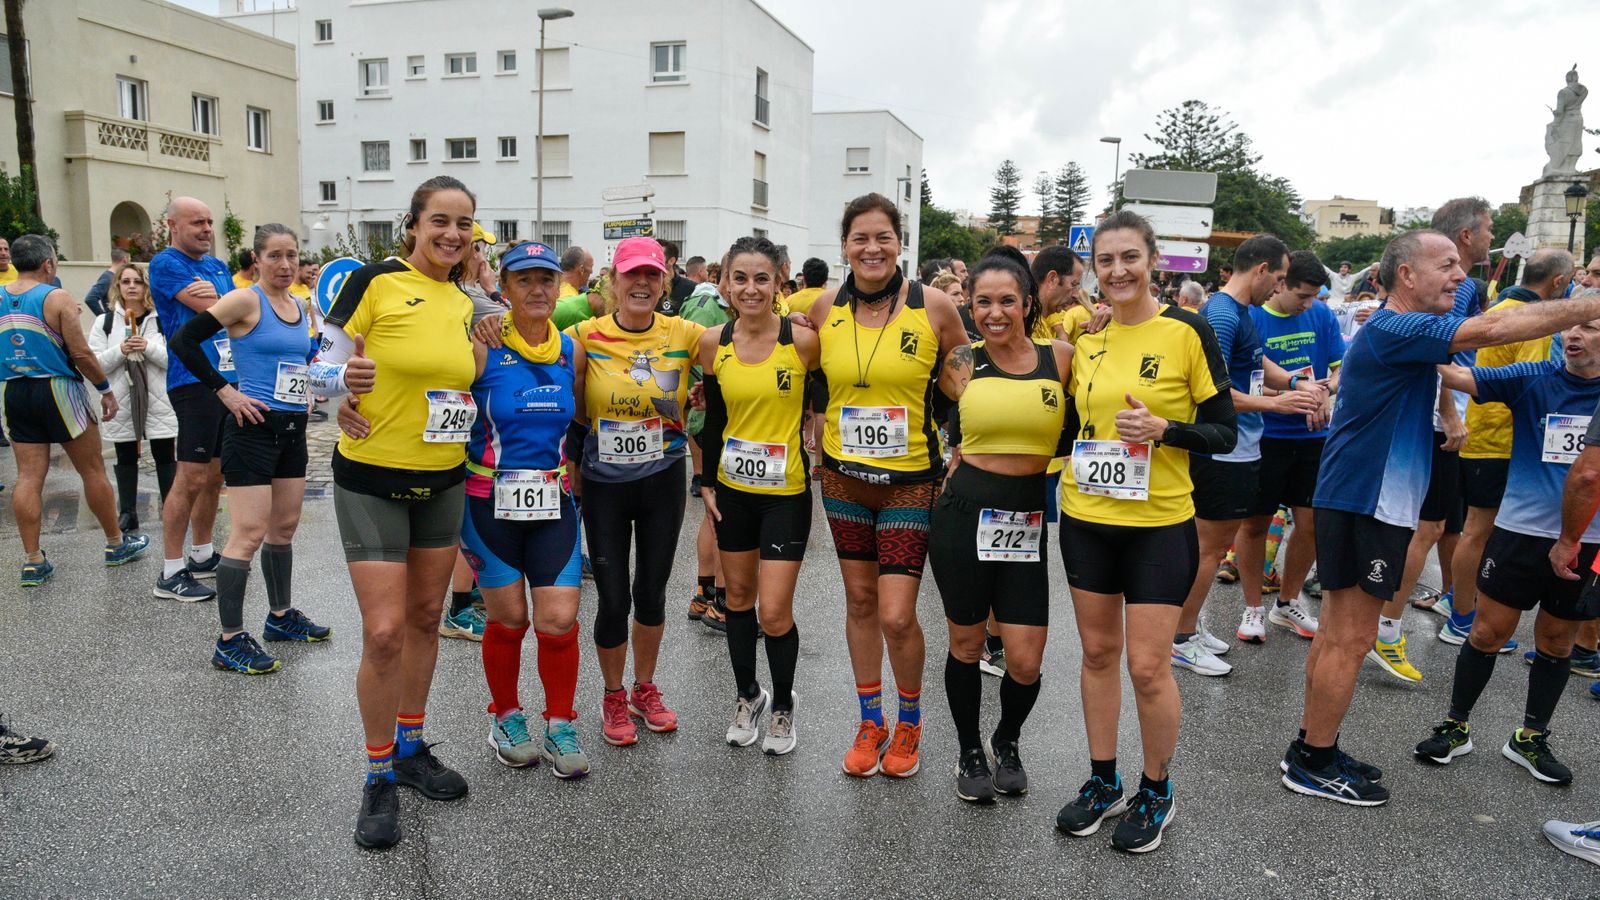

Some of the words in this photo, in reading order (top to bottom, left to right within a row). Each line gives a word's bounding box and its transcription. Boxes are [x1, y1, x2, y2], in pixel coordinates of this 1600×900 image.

[289, 378, 307, 395] 23
[440, 408, 467, 430] 249
[613, 435, 647, 454] 306
[854, 424, 889, 446] 196
[1084, 442, 1097, 451] XIII
[735, 457, 767, 478] 209
[1088, 460, 1126, 485] 208
[512, 487, 544, 508] 161
[991, 528, 1026, 549] 212
